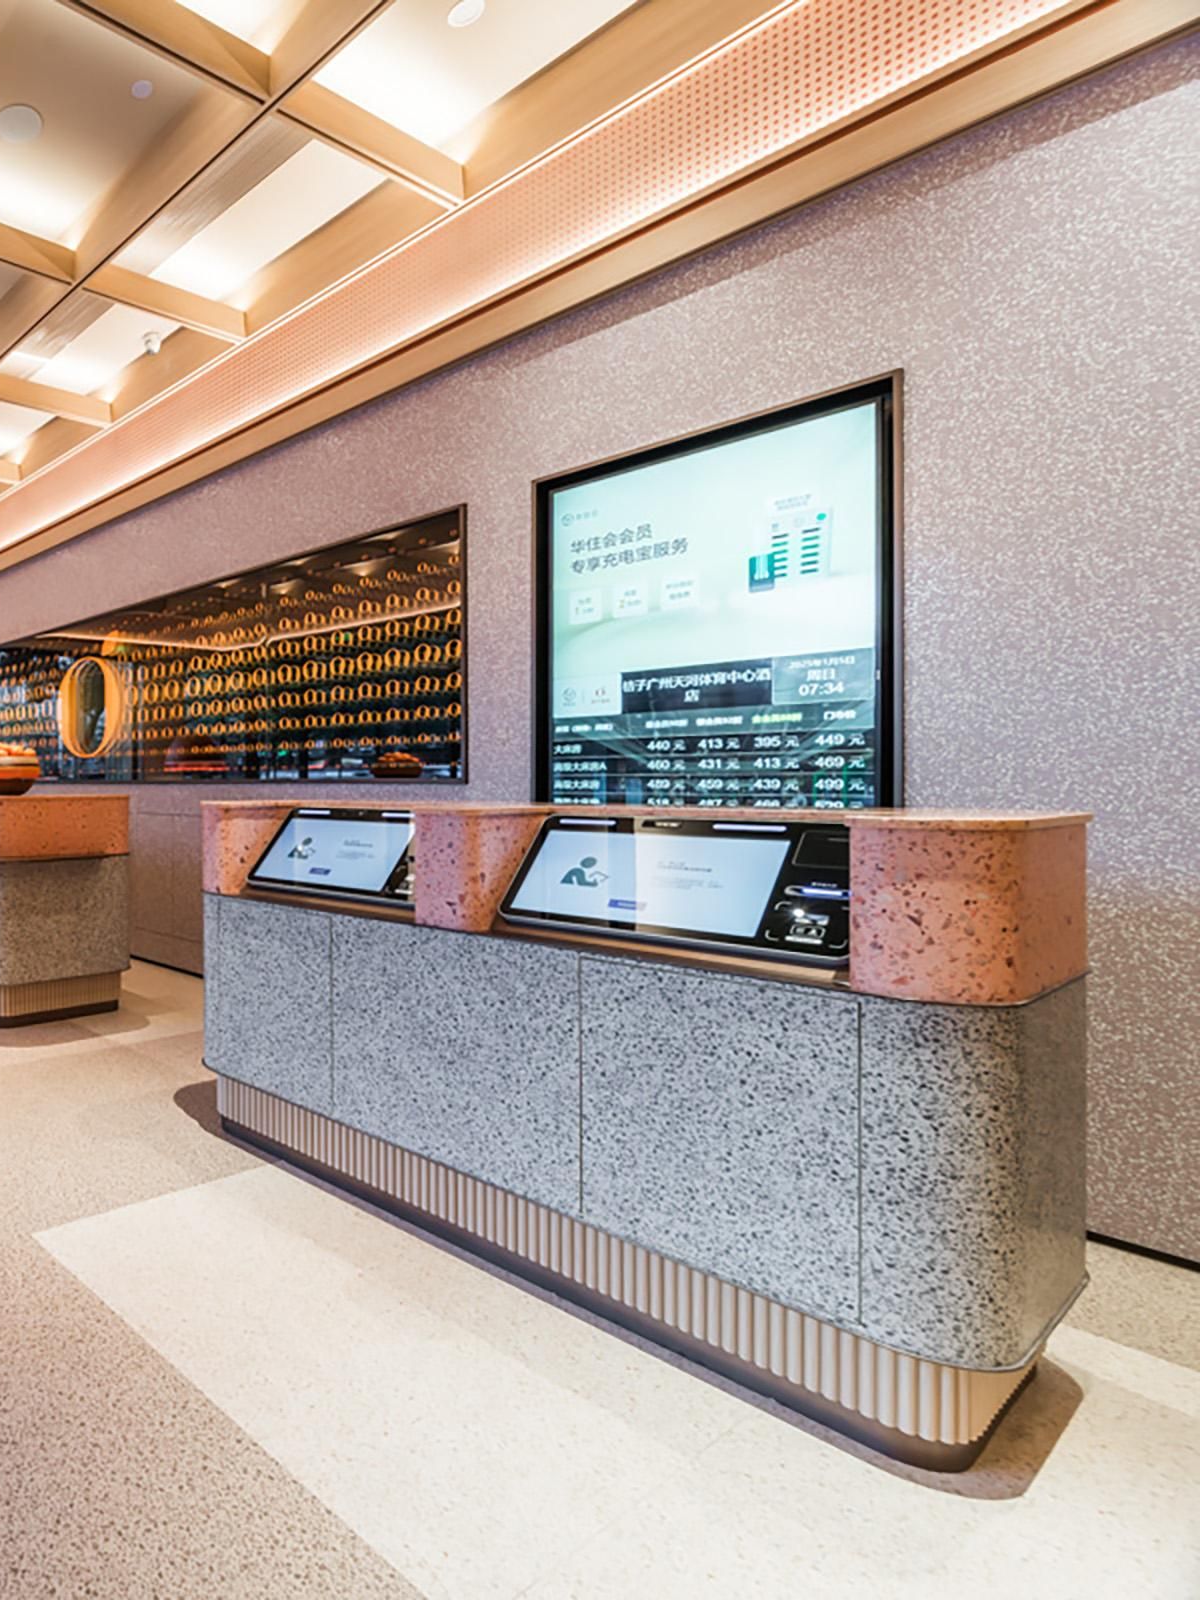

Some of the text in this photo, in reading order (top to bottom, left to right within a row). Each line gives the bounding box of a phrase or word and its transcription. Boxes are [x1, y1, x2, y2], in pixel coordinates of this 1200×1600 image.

[570, 523, 653, 554] 华住会会员
[570, 537, 689, 574] 专享充电宝服务
[806, 668, 836, 682] 周日
[683, 689, 700, 702] 店
[798, 681, 845, 697] 07:34
[672, 739, 686, 751] 元
[698, 738, 723, 749] 413
[726, 737, 740, 749] 元
[754, 736, 781, 748] 395
[784, 735, 800, 748] 元
[815, 734, 845, 746] 449
[848, 733, 865, 746] 元
[672, 759, 686, 770] 元
[698, 758, 722, 769] 431
[726, 757, 740, 770] 元
[753, 757, 781, 769] 413
[784, 757, 800, 769] 元
[815, 756, 845, 768] 469
[848, 755, 865, 769] 元
[672, 778, 686, 790] 元
[726, 778, 740, 791] 元
[753, 778, 781, 789] 439
[784, 778, 800, 791] 元
[815, 778, 845, 790] 499
[848, 778, 865, 791] 元
